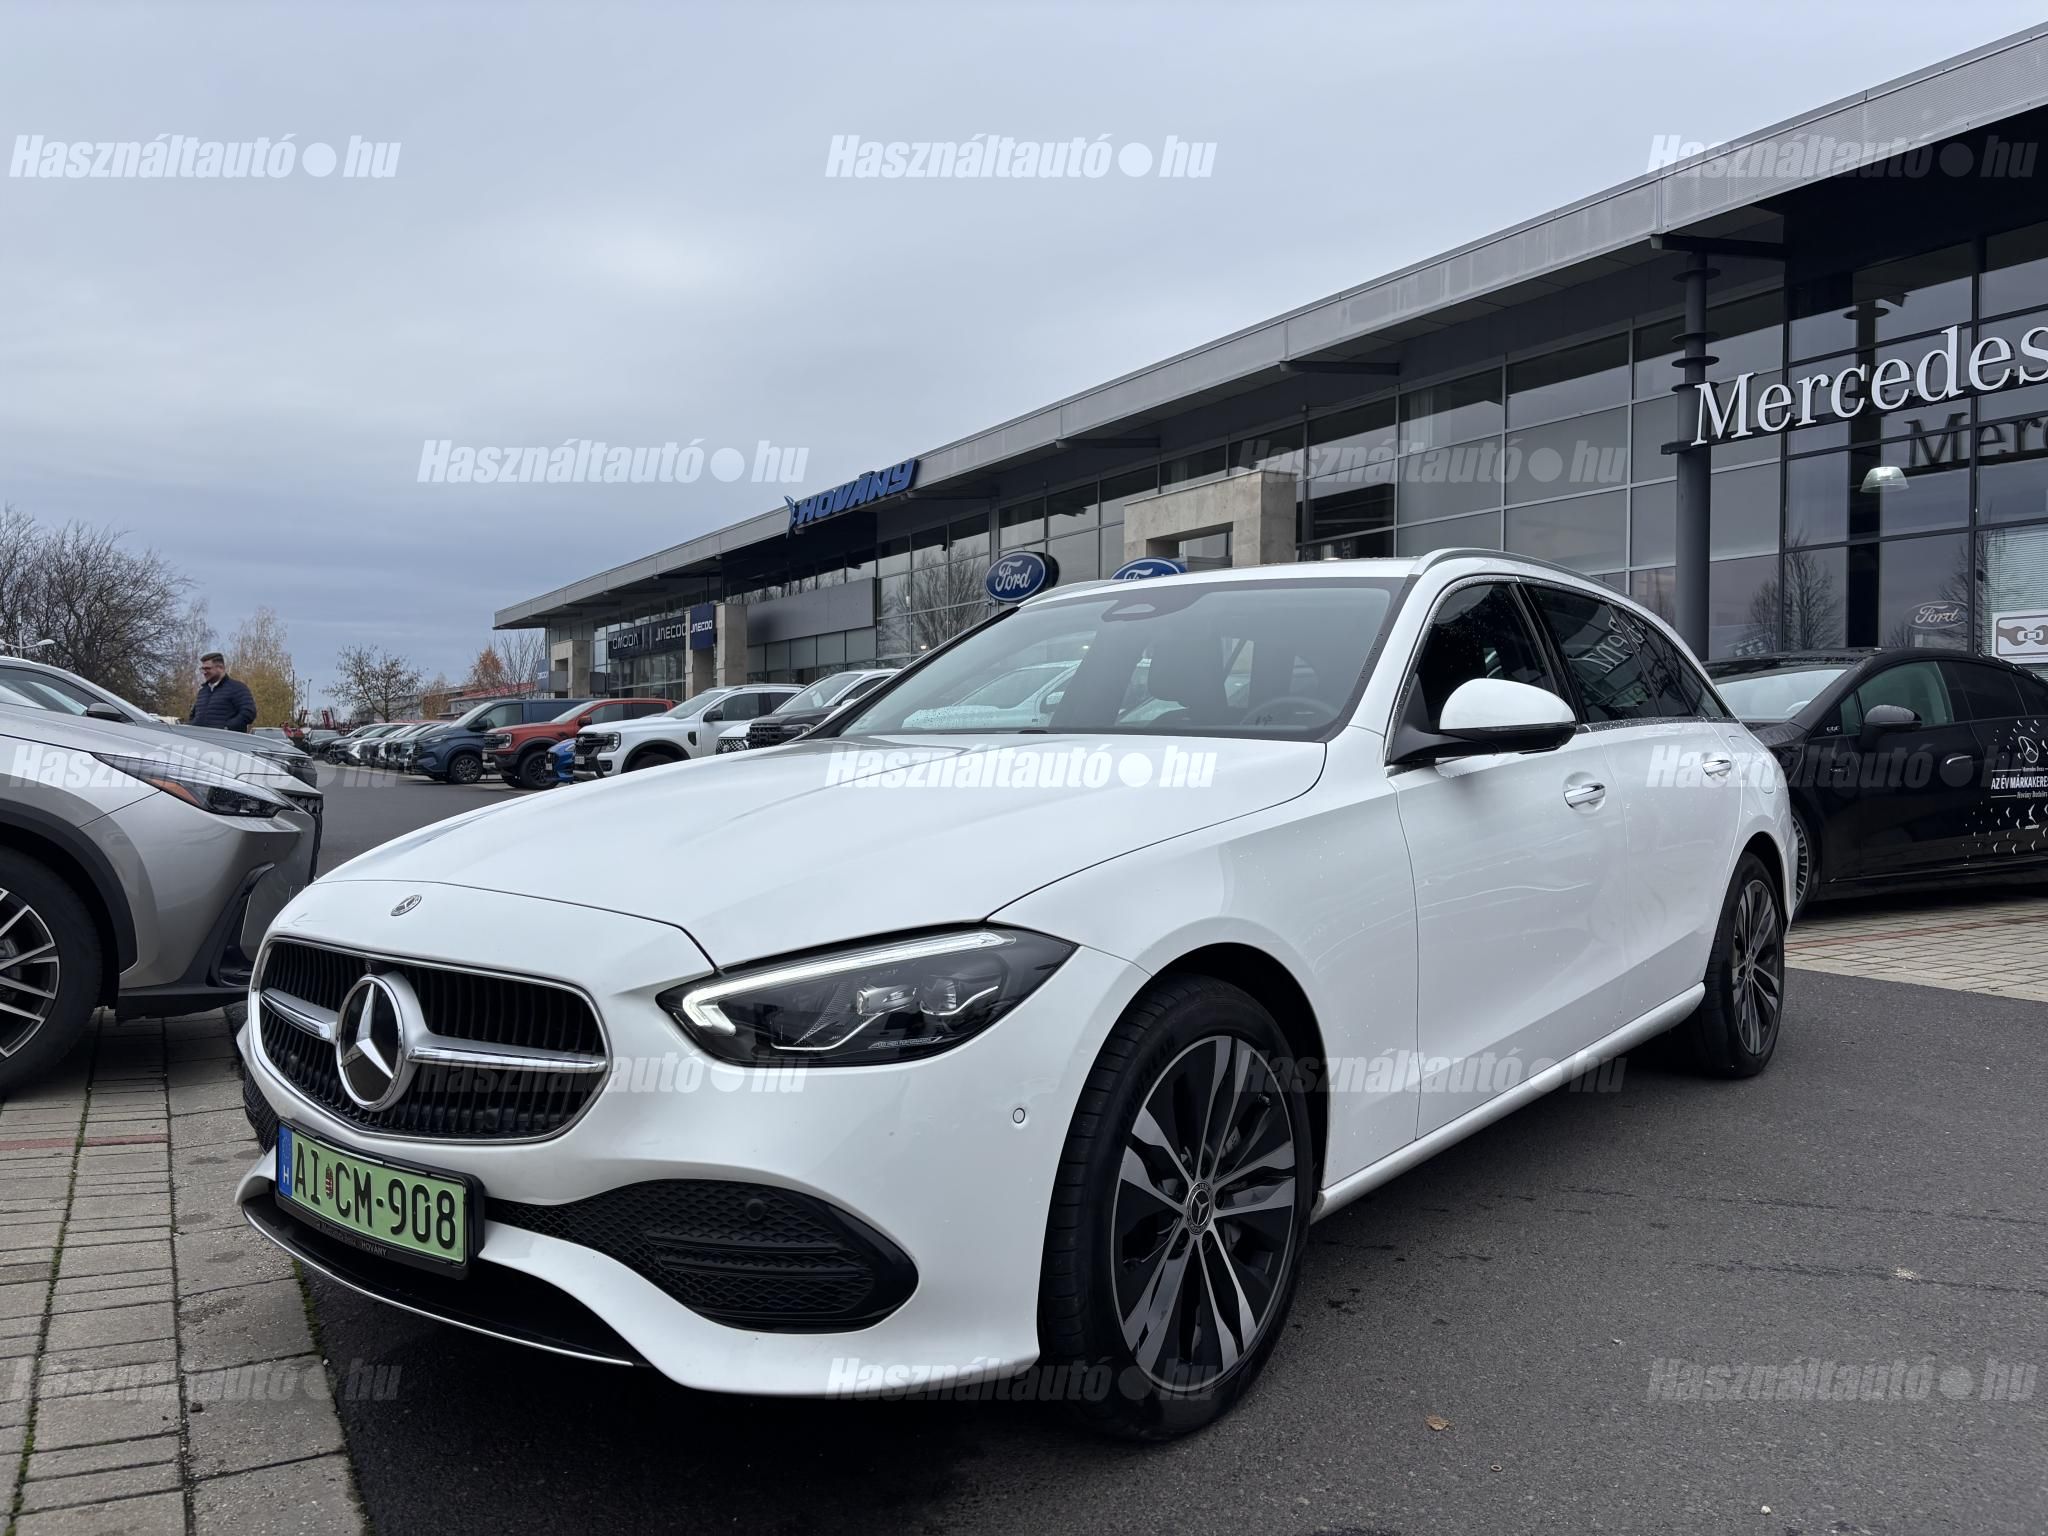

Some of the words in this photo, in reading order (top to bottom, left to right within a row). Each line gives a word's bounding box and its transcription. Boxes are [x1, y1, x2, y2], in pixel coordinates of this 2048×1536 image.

[1691, 325, 2048, 446] Mercedes
[797, 458, 917, 525] HOVÁNY
[995, 559, 1032, 592] Ford
[2010, 773, 2048, 789] MÁRKAKERE
[282, 1165, 291, 1185] H
